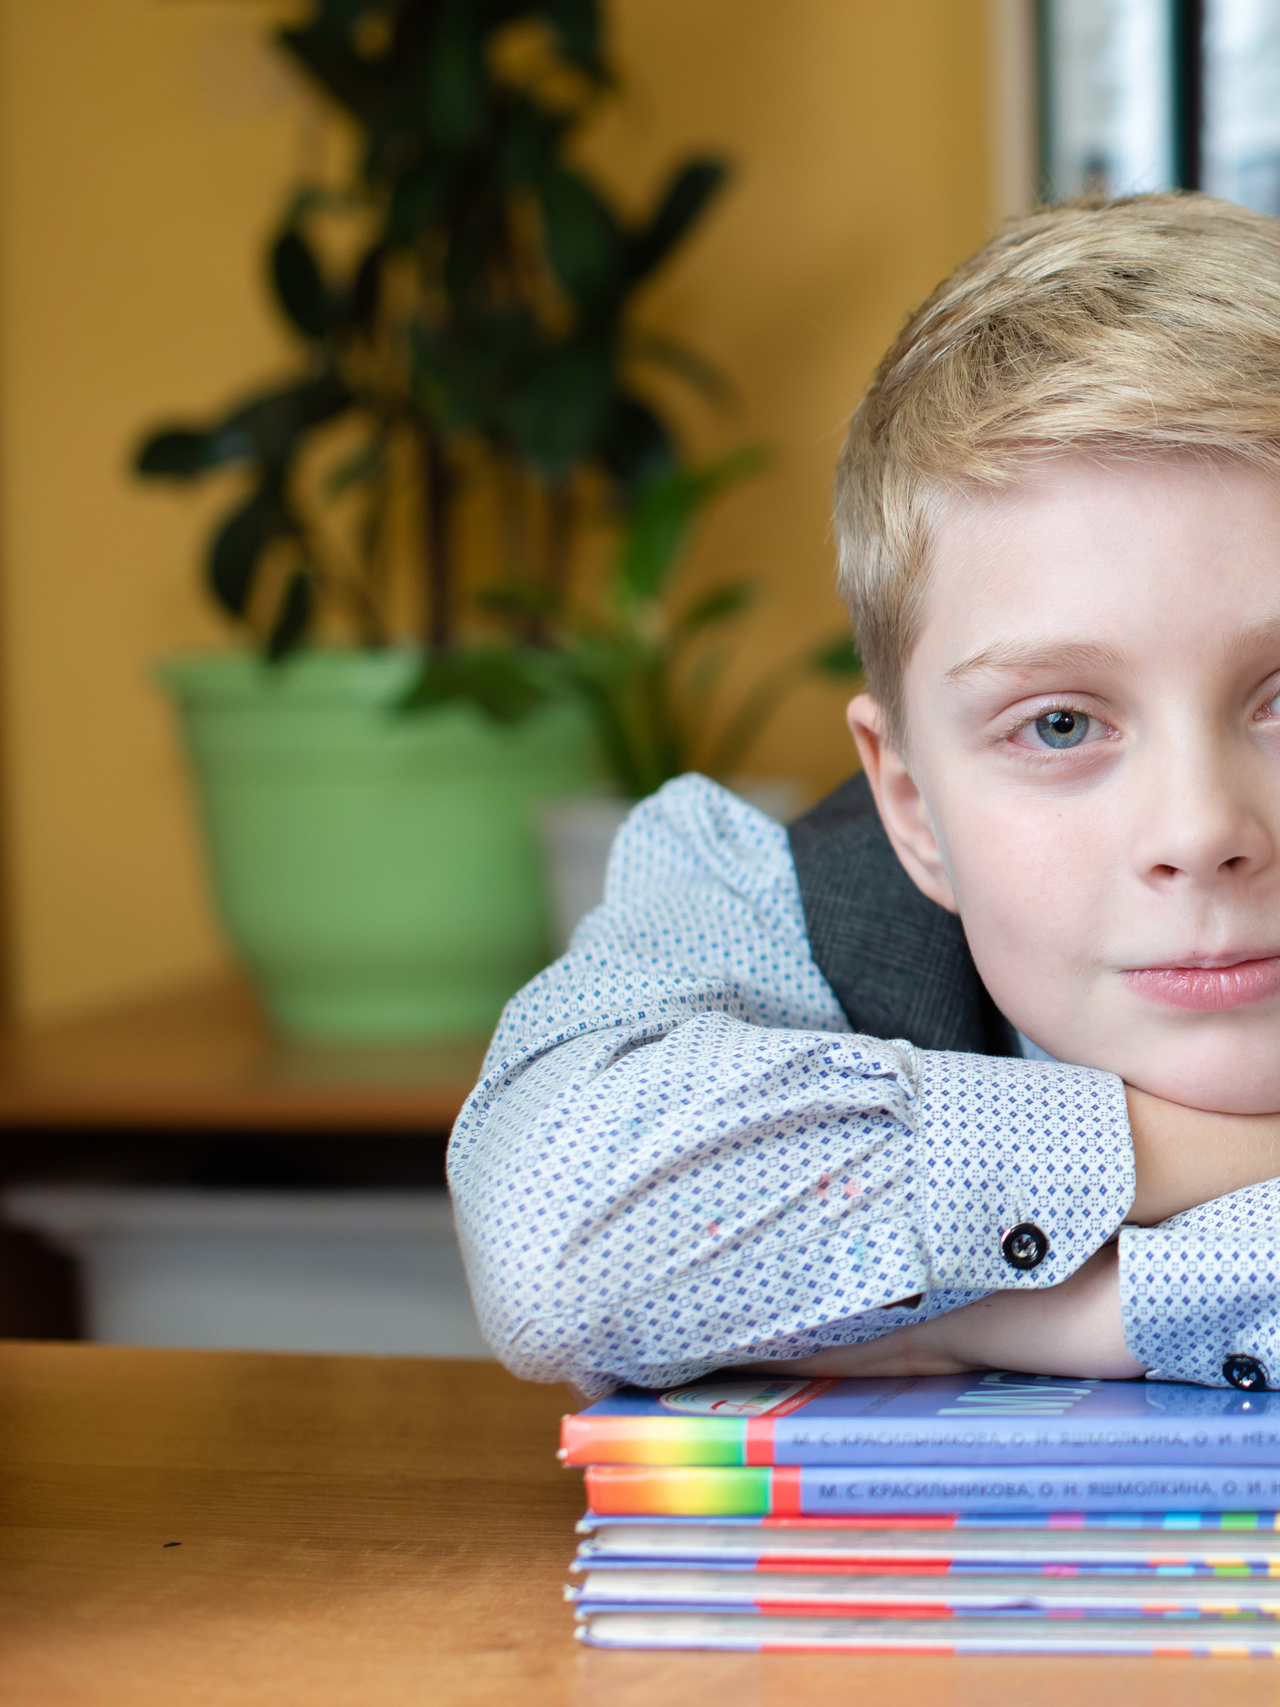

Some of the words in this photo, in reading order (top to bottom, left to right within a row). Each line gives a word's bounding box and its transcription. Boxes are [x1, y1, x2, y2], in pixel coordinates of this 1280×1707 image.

[1193, 1431, 1213, 1447] О.
[819, 1483, 842, 1497] М.
[868, 1482, 1034, 1499] КРАСИЛЬНИКОВА,
[1039, 1481, 1059, 1496] О.
[1063, 1482, 1080, 1497] Н.
[1222, 1479, 1243, 1496] О.
[1248, 1480, 1264, 1496] И.
